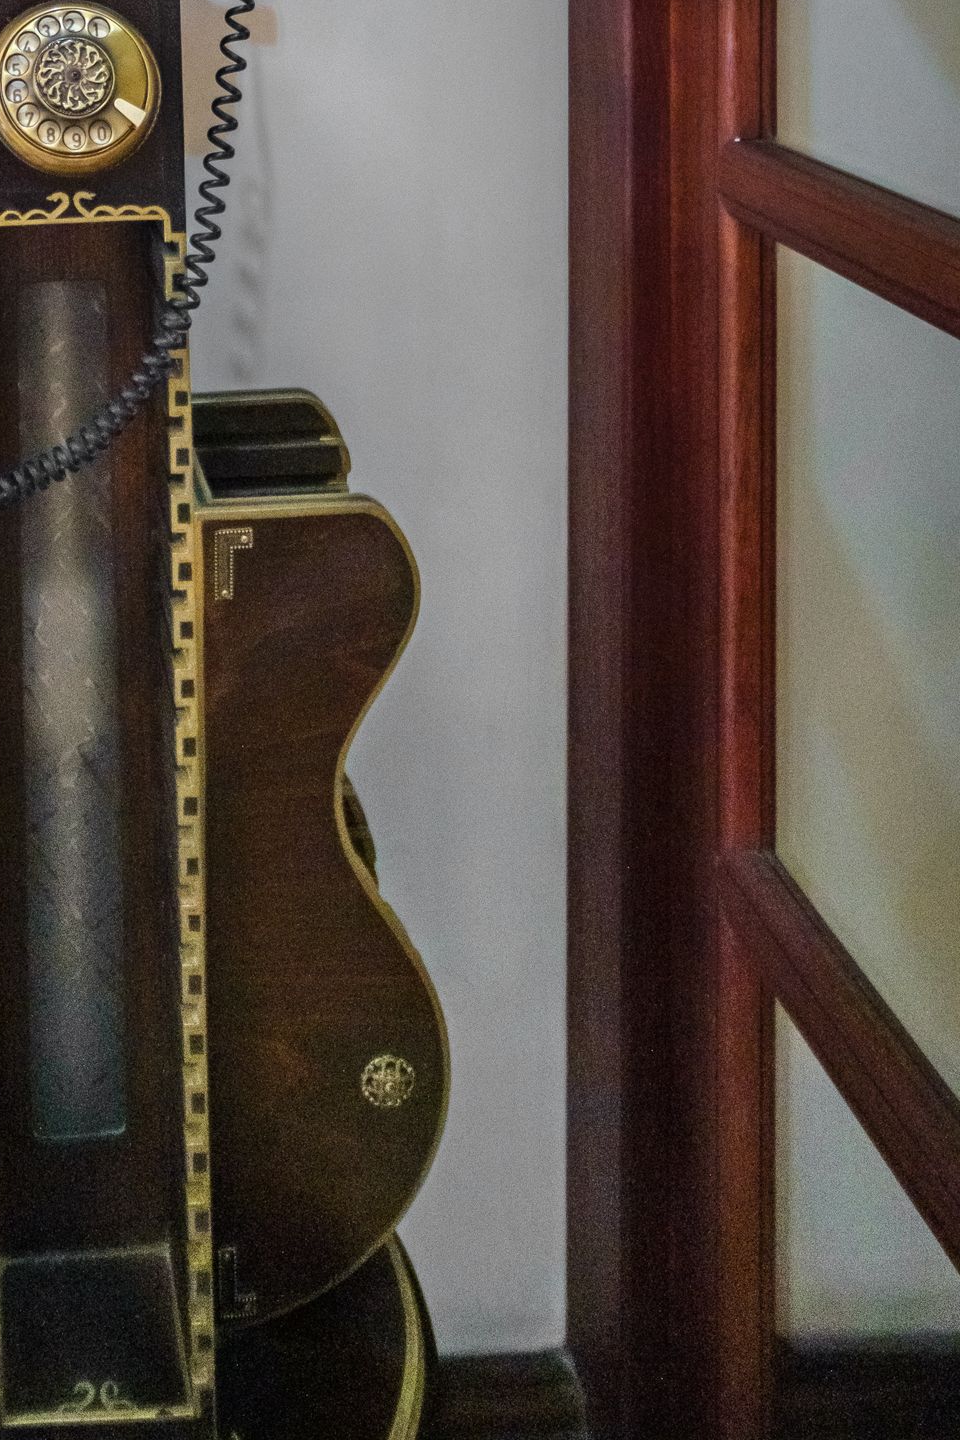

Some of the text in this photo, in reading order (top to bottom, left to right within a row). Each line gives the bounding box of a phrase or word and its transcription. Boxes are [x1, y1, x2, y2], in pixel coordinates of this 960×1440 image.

[42, 24, 51, 36] 3
[65, 18, 75, 32] 2
[92, 21, 99, 36] 1
[11, 63, 21, 76] 5
[13, 88, 22, 102] 6
[25, 111, 34, 127] 7
[46, 127, 55, 142] 8
[72, 132, 81, 147] 9
[97, 126, 107, 141] 0
